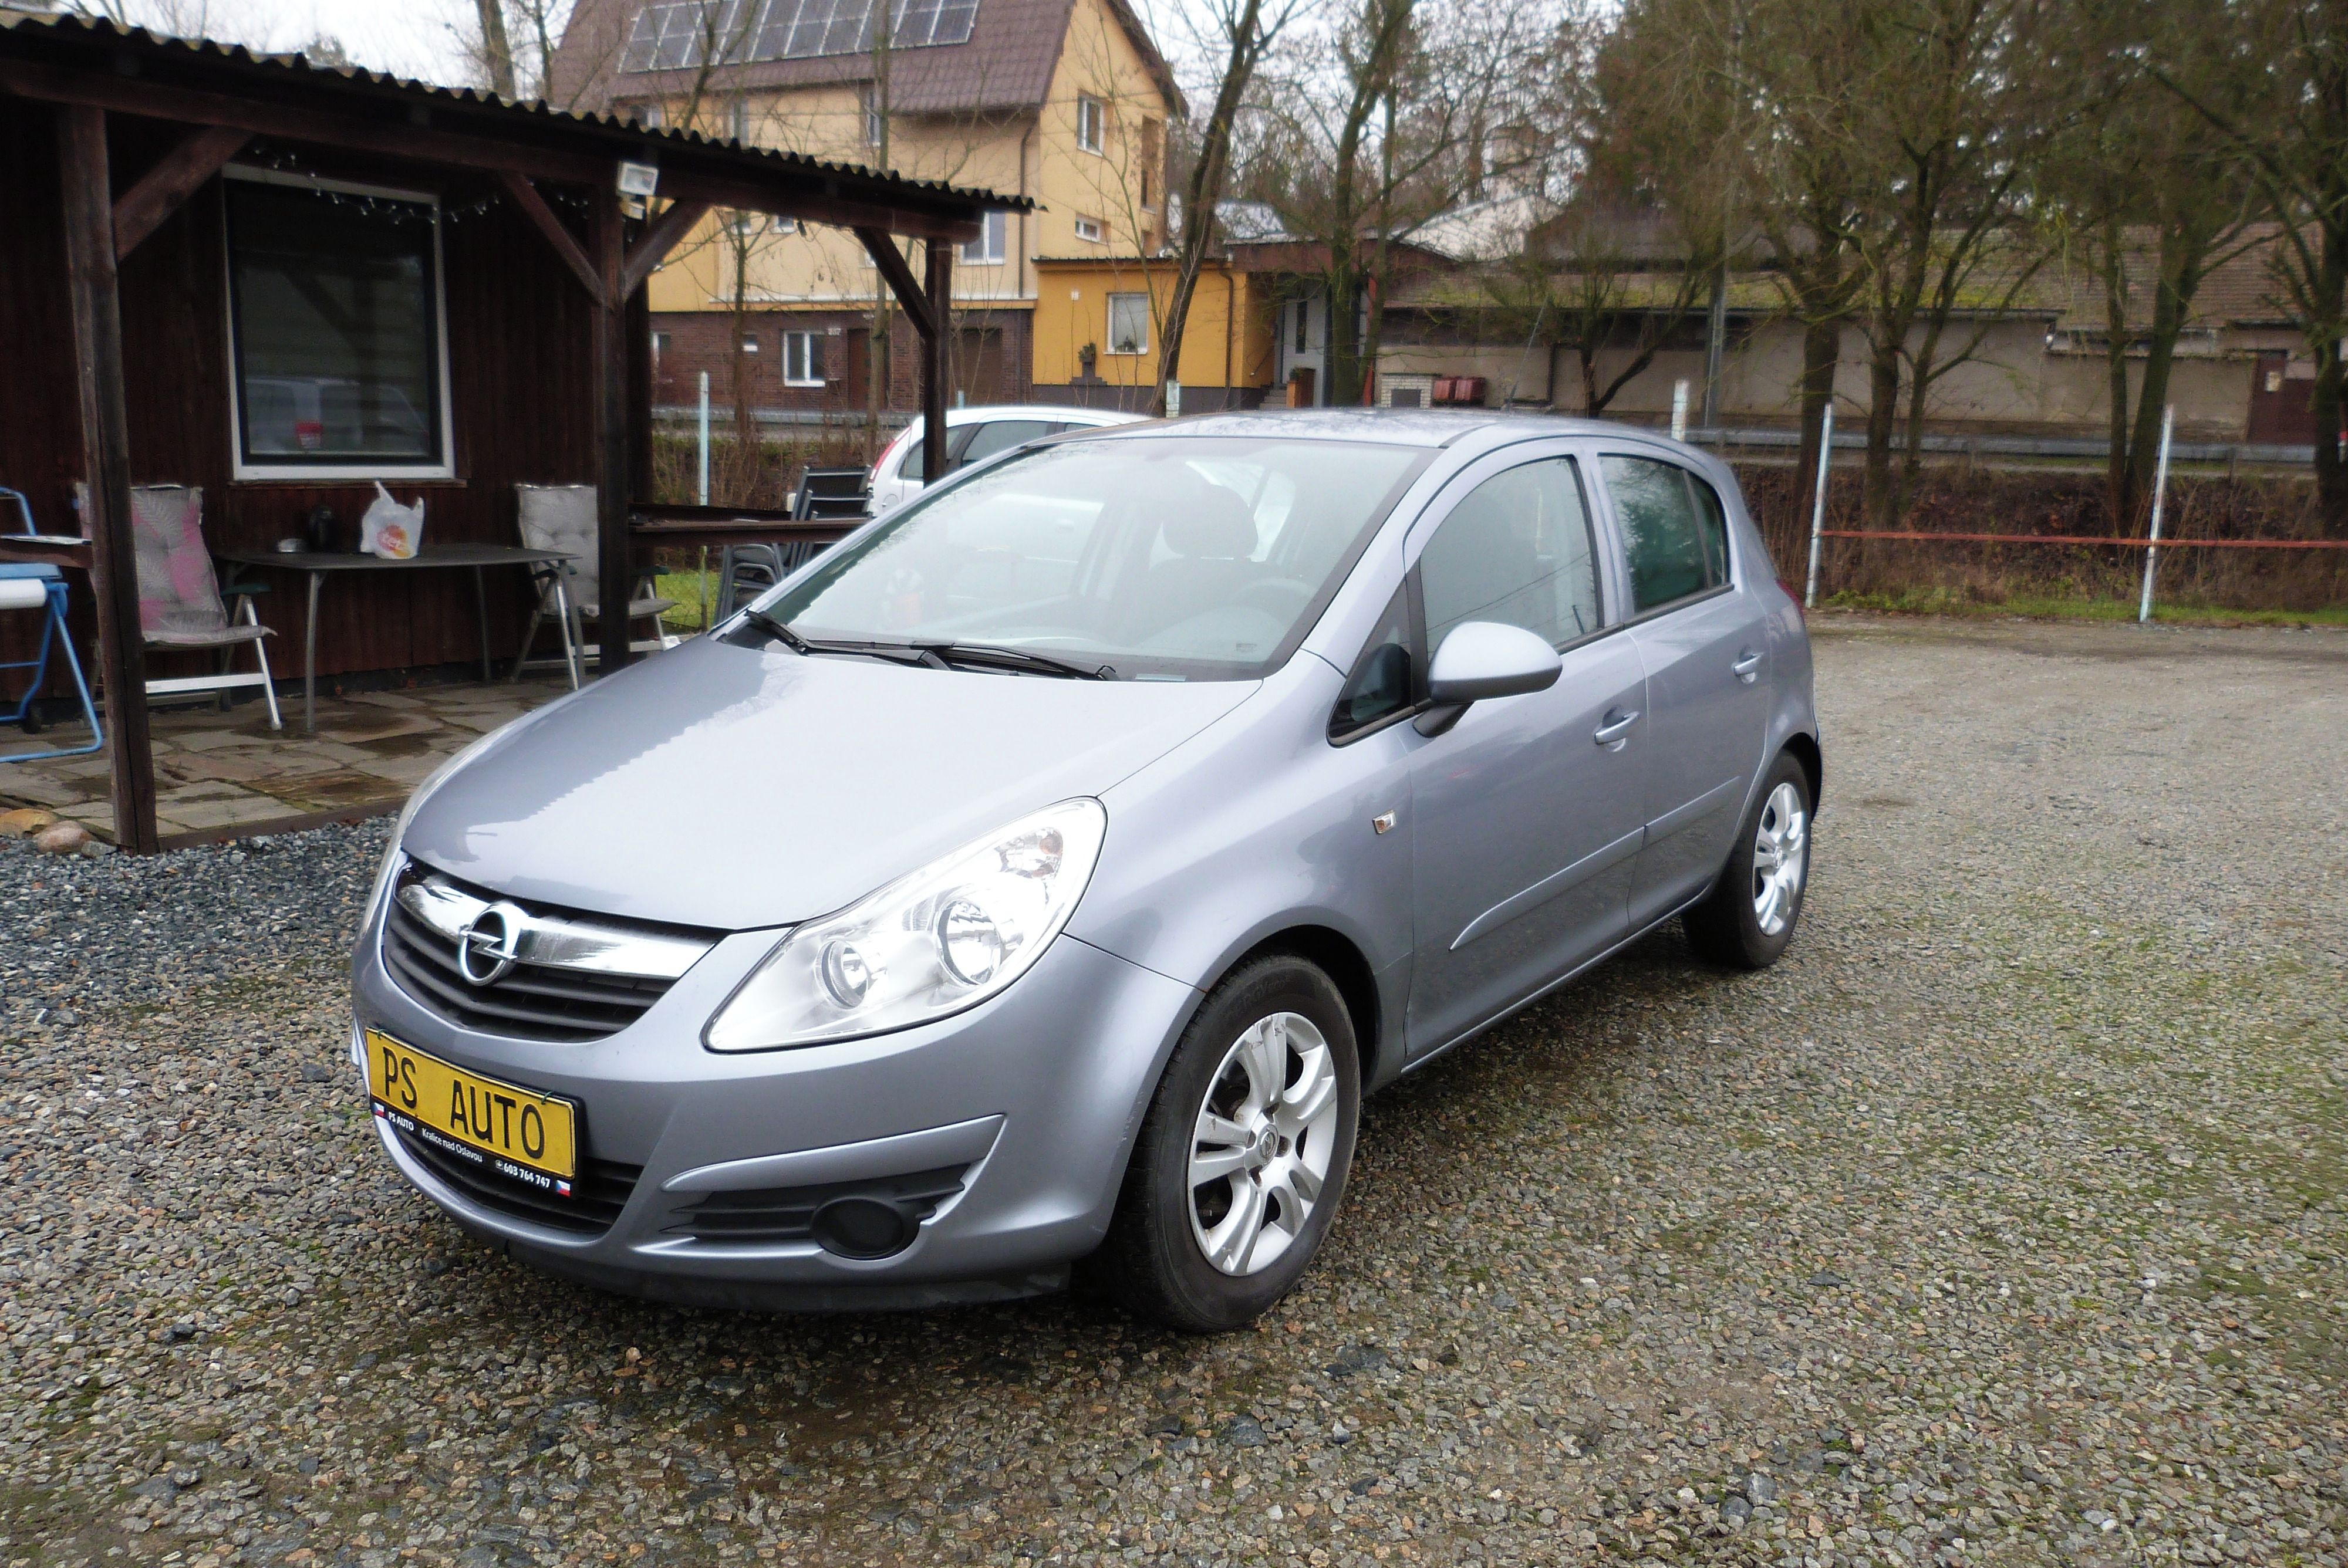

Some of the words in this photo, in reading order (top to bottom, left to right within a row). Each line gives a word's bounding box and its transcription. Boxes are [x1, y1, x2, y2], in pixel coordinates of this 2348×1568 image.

[383, 1046, 417, 1109] PS
[450, 1079, 545, 1159] AUTO
[388, 1111, 396, 1123] PS
[397, 1116, 414, 1131] AUTO
[422, 1128, 442, 1144] Kralice
[443, 1140, 455, 1151] nad
[456, 1144, 483, 1163] Oslavou
[504, 1163, 518, 1177] 603
[519, 1168, 534, 1182] 764
[535, 1174, 551, 1188] 747
